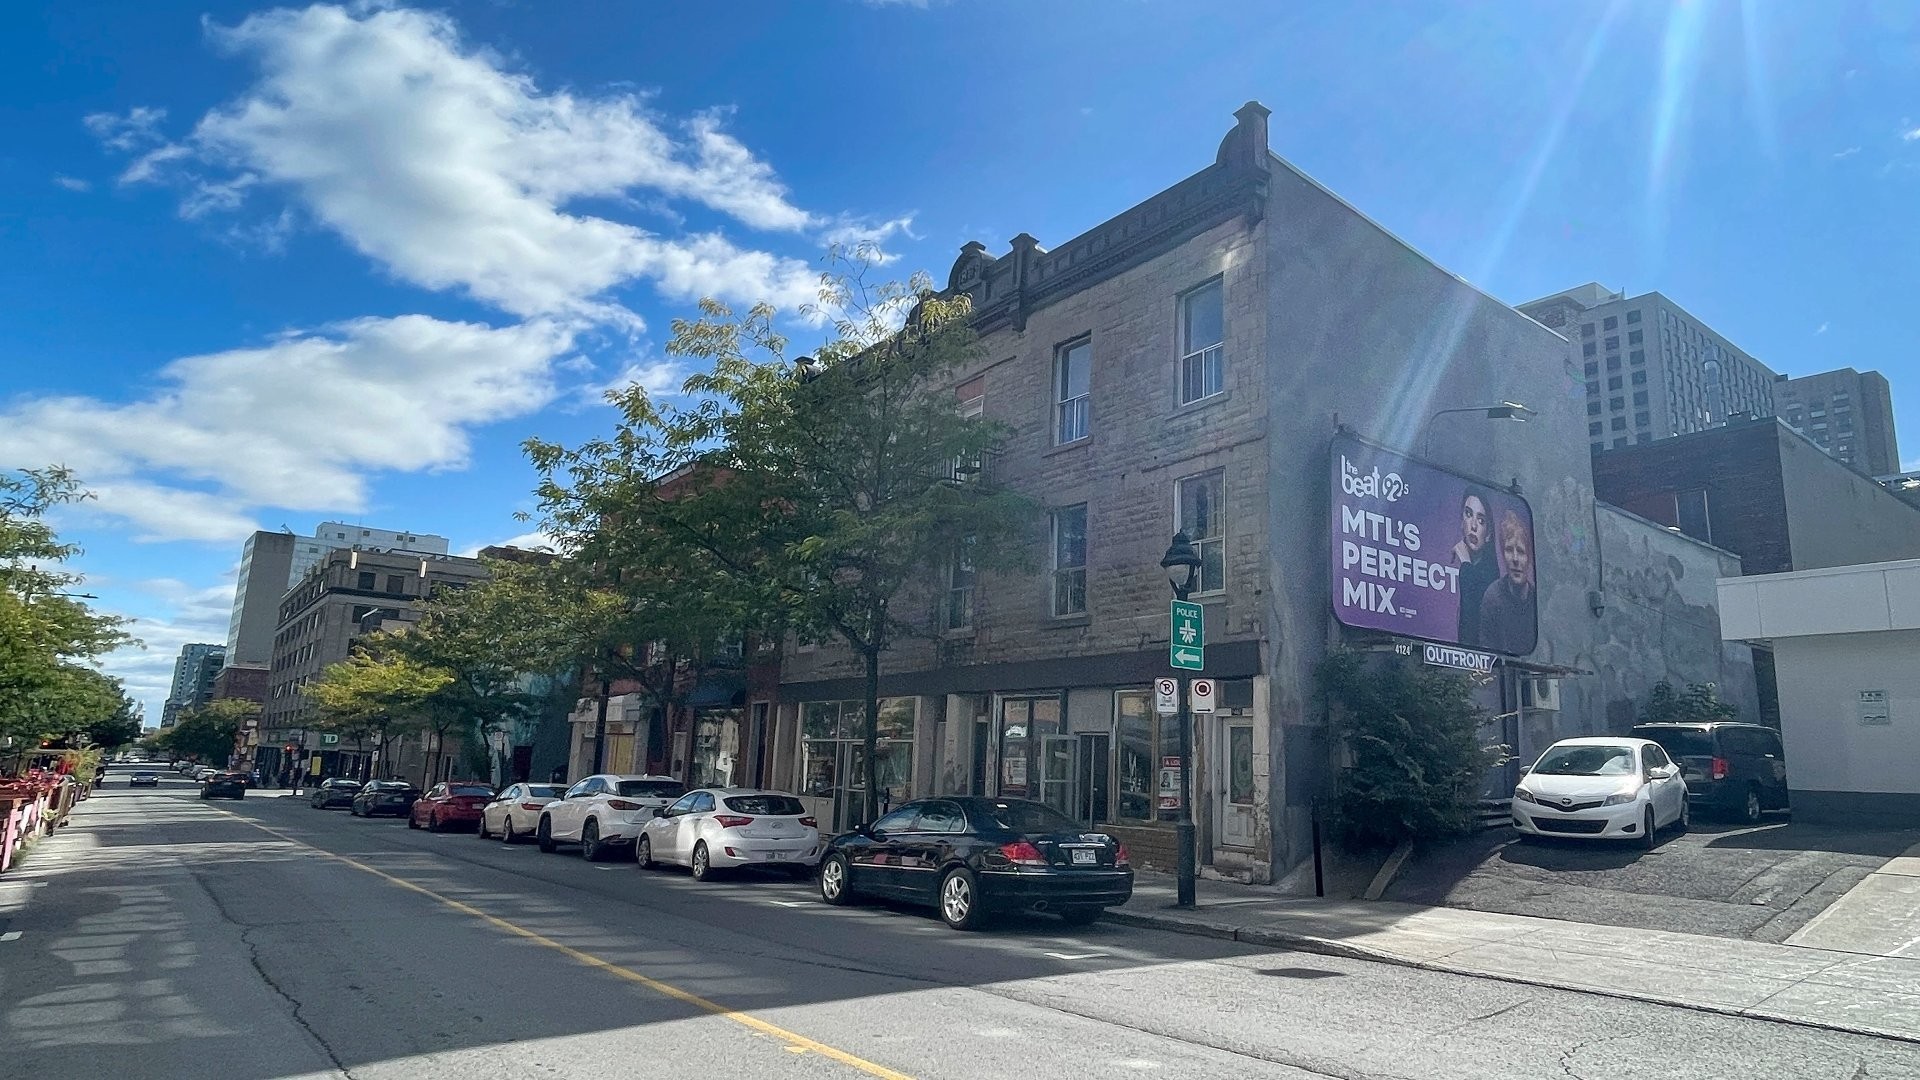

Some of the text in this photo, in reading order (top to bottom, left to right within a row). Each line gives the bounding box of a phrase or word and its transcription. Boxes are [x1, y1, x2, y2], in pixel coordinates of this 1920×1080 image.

[1341, 454, 1380, 499] beat
[1346, 460, 1358, 475] the
[1342, 505, 1421, 551] MTL'S
[1342, 541, 1459, 593] PERFECT
[1342, 578, 1397, 615] MIX
[1176, 607, 1198, 619] POLICE
[1395, 644, 1411, 656] 4124
[1426, 646, 1490, 669] OUTFRONT
[323, 734, 338, 743] TD
